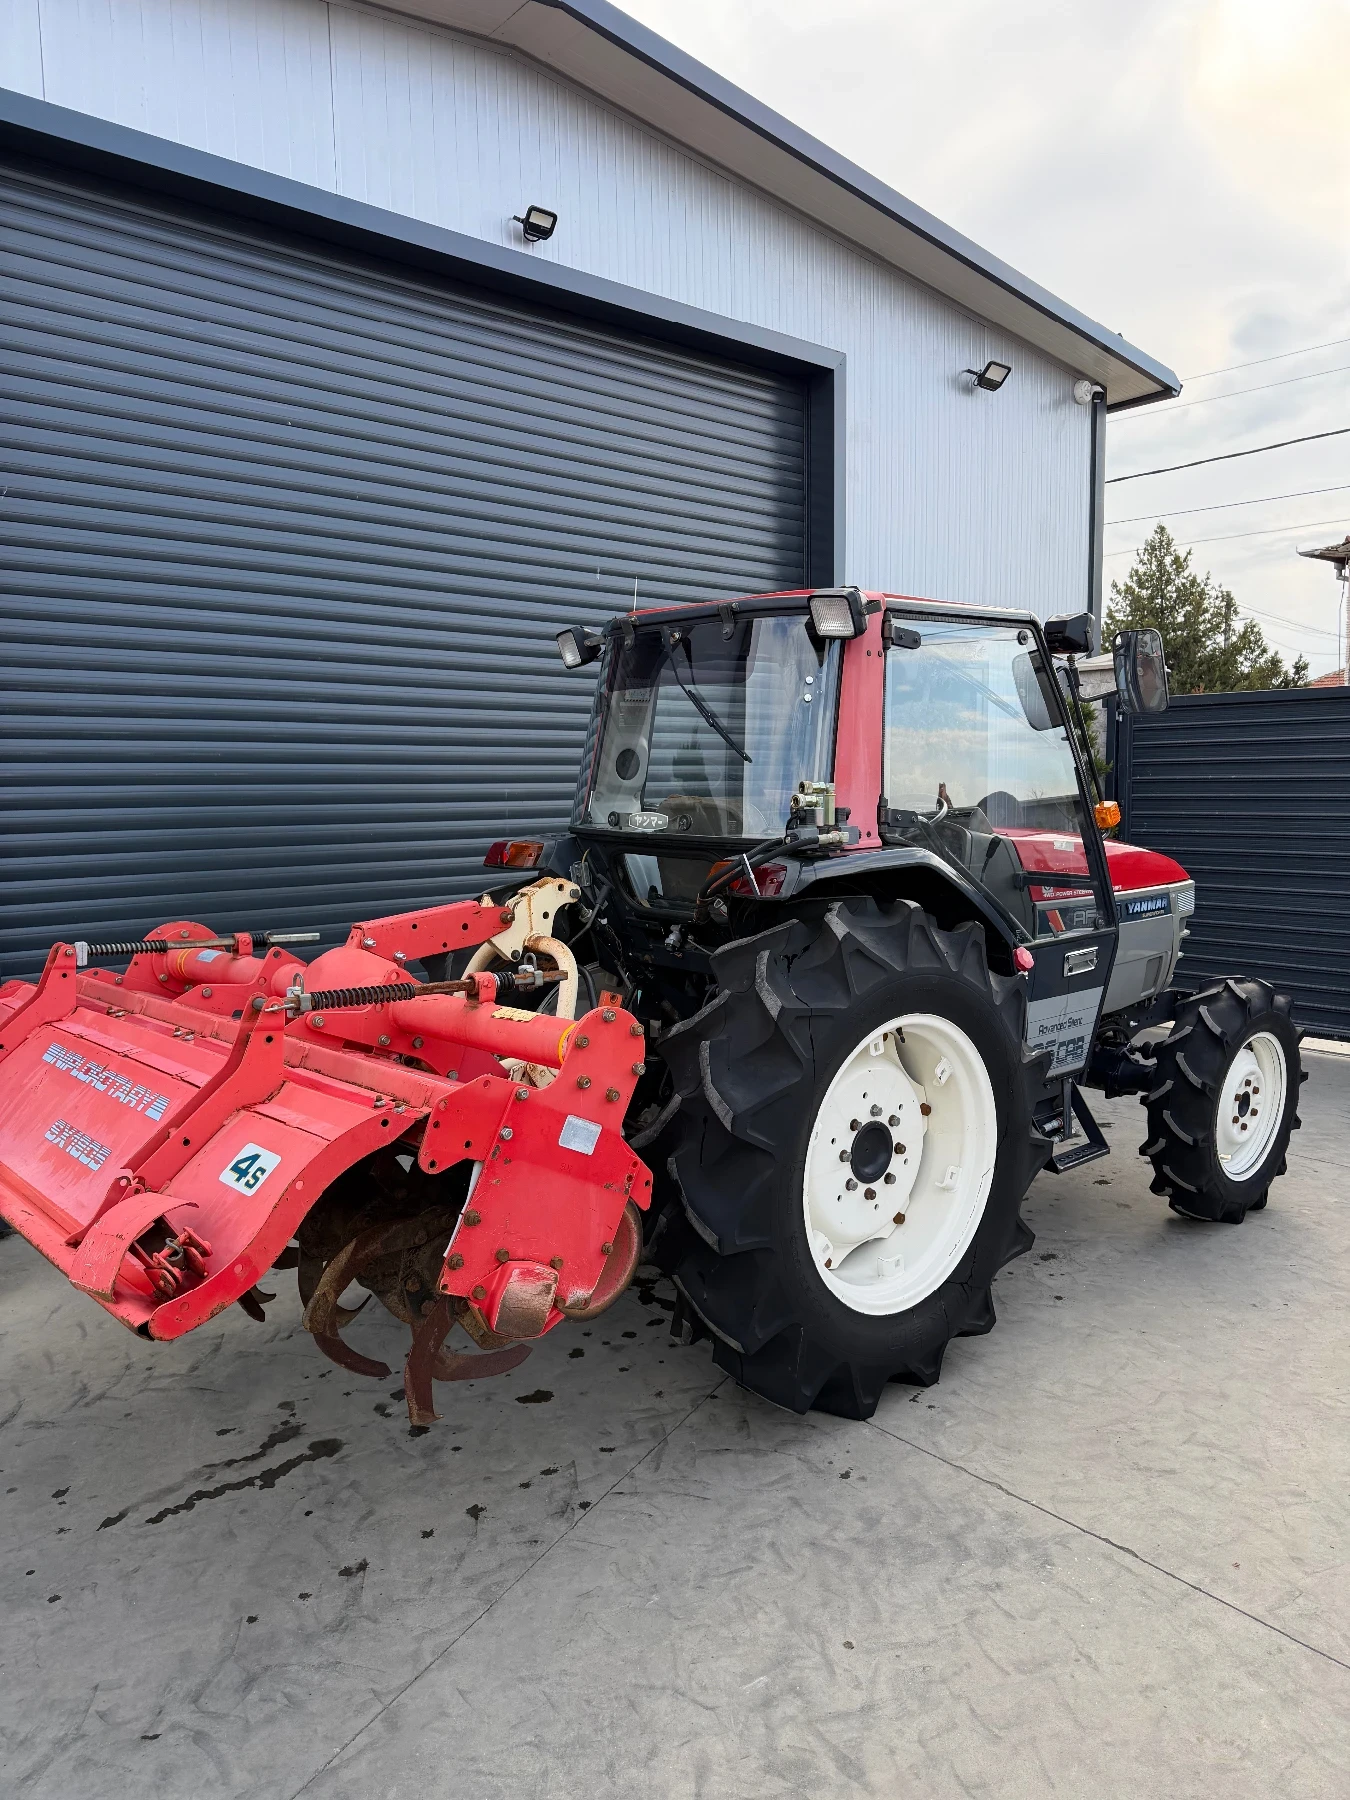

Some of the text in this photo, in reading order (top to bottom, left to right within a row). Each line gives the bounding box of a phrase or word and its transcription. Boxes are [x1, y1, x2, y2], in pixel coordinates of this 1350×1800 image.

[634, 814, 663, 827] ヤンマー
[1056, 889, 1073, 897] POWER
[1127, 897, 1168, 914] YANMAR
[1038, 1019, 1067, 1036] Advanced
